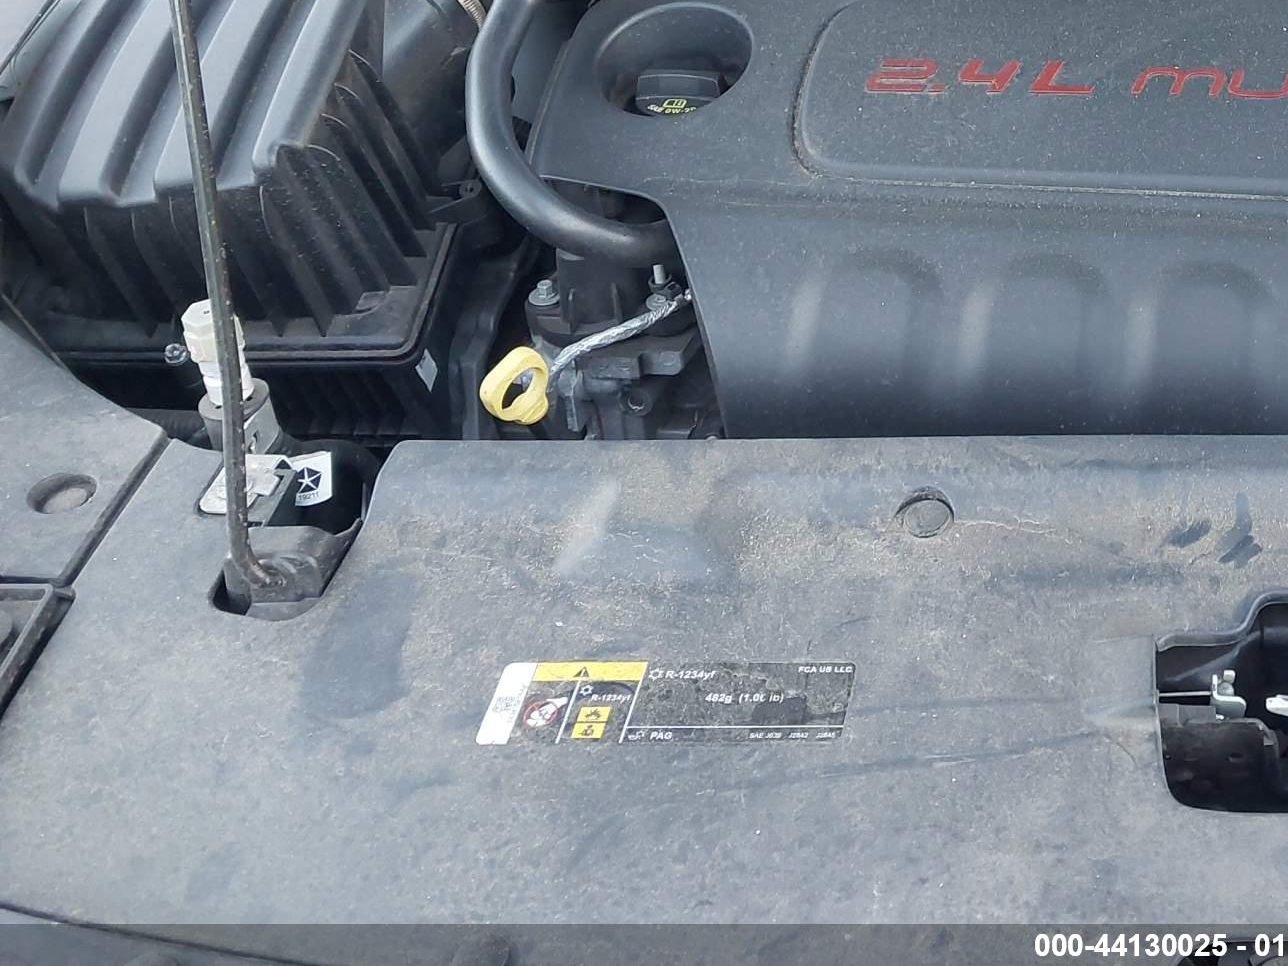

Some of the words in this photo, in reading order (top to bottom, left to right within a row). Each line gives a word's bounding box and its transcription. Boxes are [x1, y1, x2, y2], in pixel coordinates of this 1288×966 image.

[798, 665, 817, 674] FCA
[834, 665, 853, 674] LLC
[664, 669, 717, 681] R-1234yf
[649, 731, 673, 740] PAG
